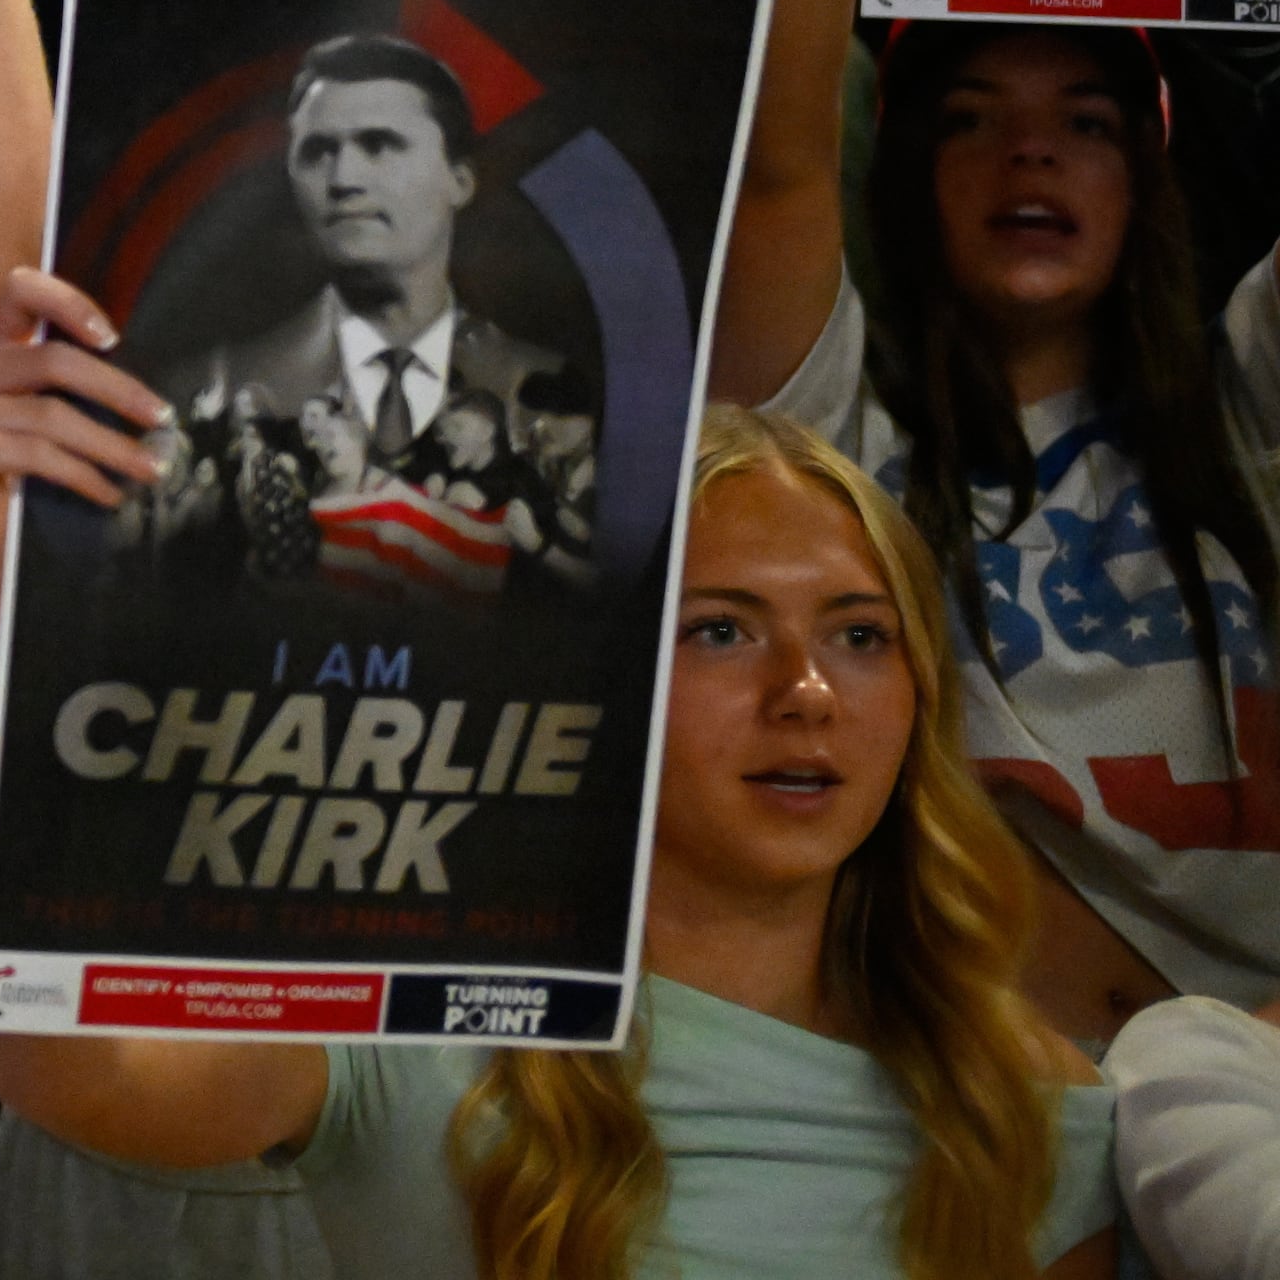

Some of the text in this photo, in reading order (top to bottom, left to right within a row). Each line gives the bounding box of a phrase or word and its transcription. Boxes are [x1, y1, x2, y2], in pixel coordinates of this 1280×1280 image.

[1233, 2, 1280, 21] POI
[271, 639, 415, 690] I AM
[52, 679, 604, 797] CHARLIE
[162, 790, 480, 896] KIRK
[92, 977, 373, 1002] IDENTIFY EMPOWER ORGANIZE
[444, 983, 549, 1006] TURNING
[184, 999, 284, 1019] TPUSA.COM
[442, 1004, 548, 1035] POINT
